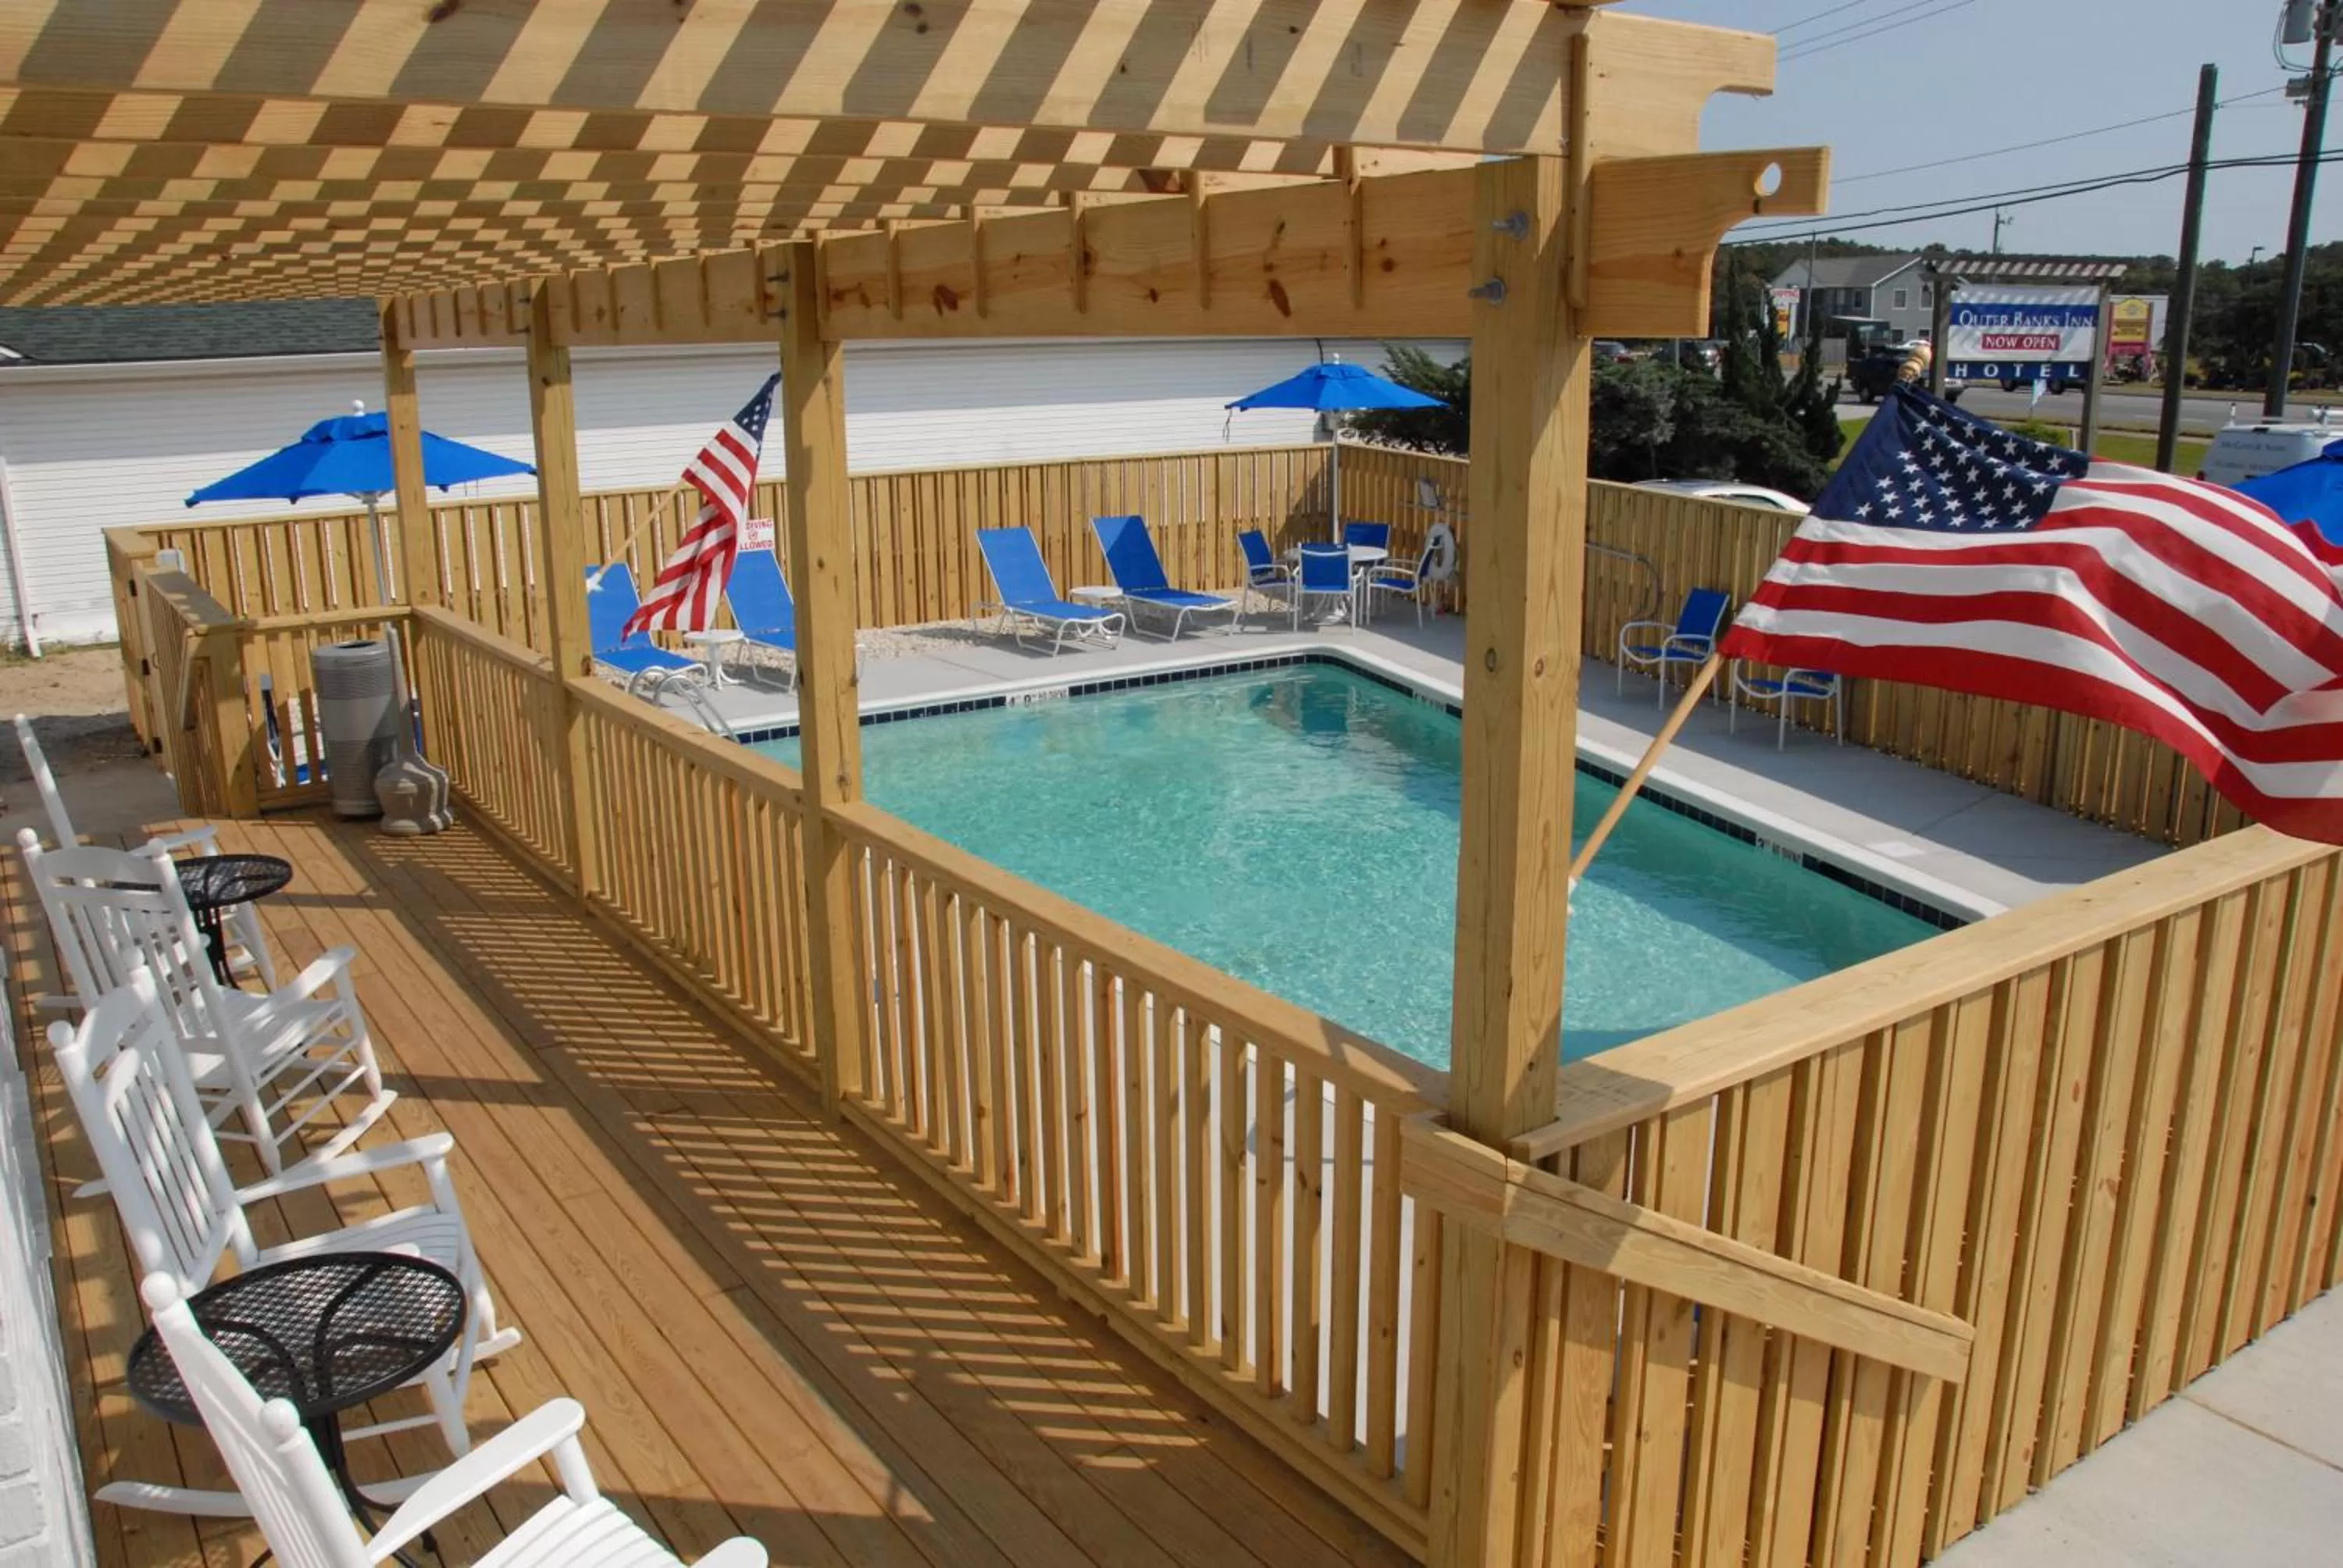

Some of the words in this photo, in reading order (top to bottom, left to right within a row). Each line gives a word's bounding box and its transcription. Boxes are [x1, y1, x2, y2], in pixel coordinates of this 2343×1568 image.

[1960, 310, 2008, 326] OUTER
[2013, 311, 2060, 326] BANKS
[2065, 312, 2094, 327] INN
[1985, 336, 2018, 347] NOW
[2022, 336, 2057, 348] OPEN
[1954, 363, 2080, 377] HOTEL
[740, 540, 772, 550] LLOWED
